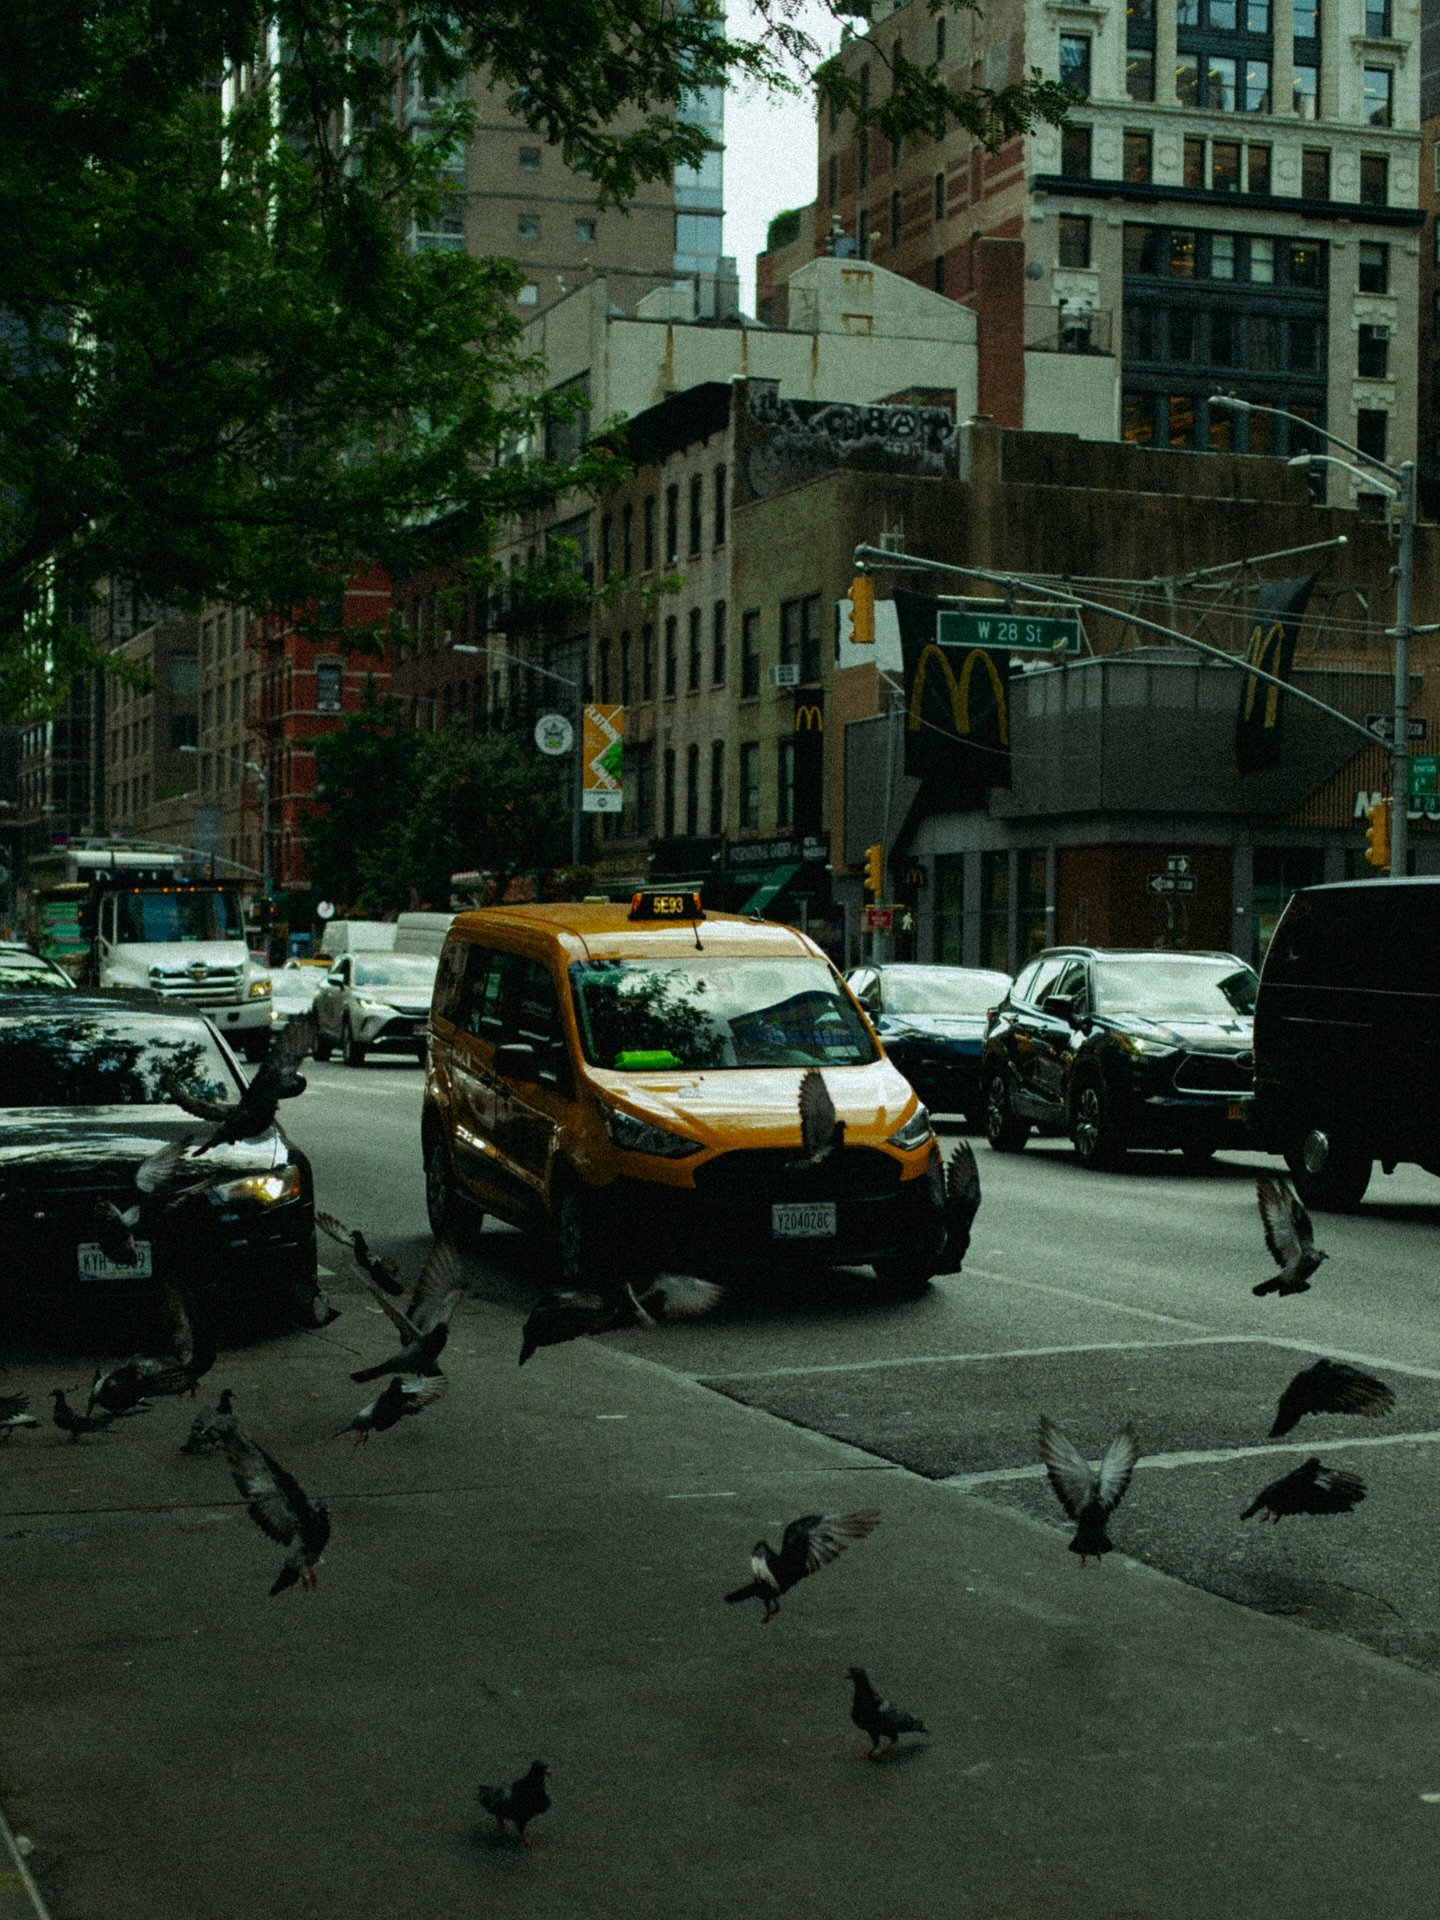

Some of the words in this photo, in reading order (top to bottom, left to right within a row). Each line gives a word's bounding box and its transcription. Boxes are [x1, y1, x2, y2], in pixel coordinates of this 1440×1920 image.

[977, 621, 991, 639] W
[997, 622, 1019, 642] 28
[1025, 624, 1042, 643] St
[652, 895, 685, 914] 5E93
